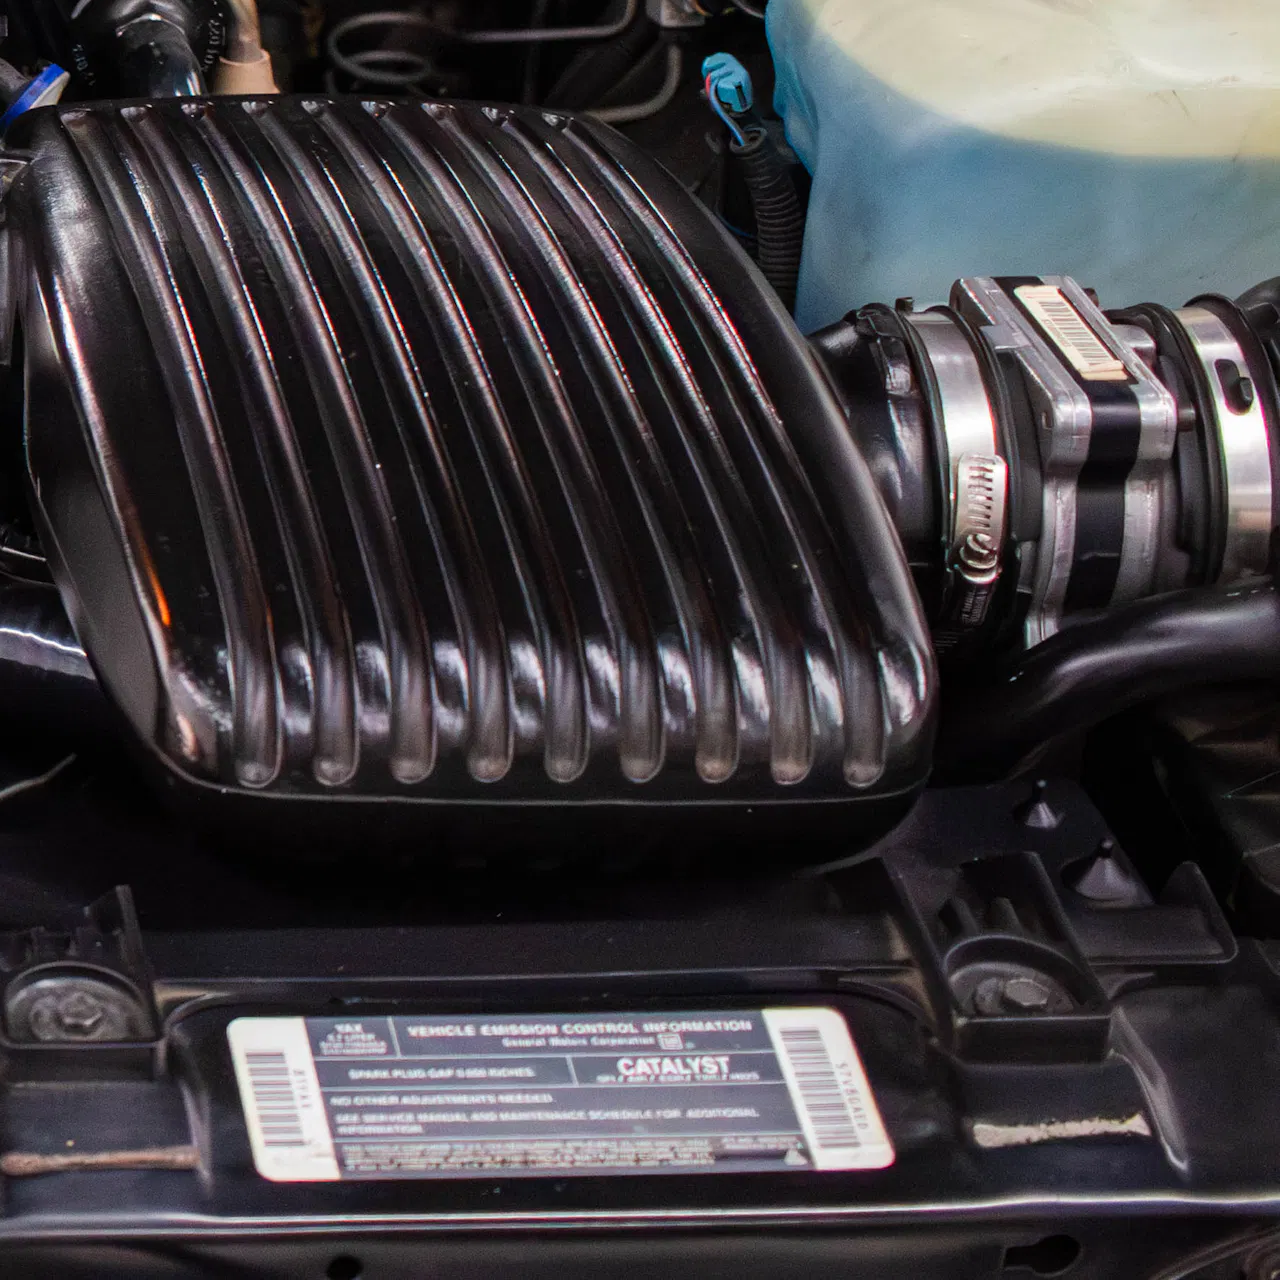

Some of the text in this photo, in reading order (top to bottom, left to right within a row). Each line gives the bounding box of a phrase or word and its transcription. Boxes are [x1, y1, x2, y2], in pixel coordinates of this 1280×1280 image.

[406, 1019, 753, 1037] VEHICLE EMISSION CONTROL INFORMATION
[501, 1037, 546, 1048] General
[589, 1035, 656, 1046] Corporation
[617, 1056, 730, 1076] CATALYST
[329, 1095, 351, 1106] NO
[352, 1094, 399, 1106] OTHER
[400, 1093, 497, 1105] ADJUSTMENTS
[361, 1111, 415, 1124] SERVICE
[654, 1108, 682, 1120] FOR
